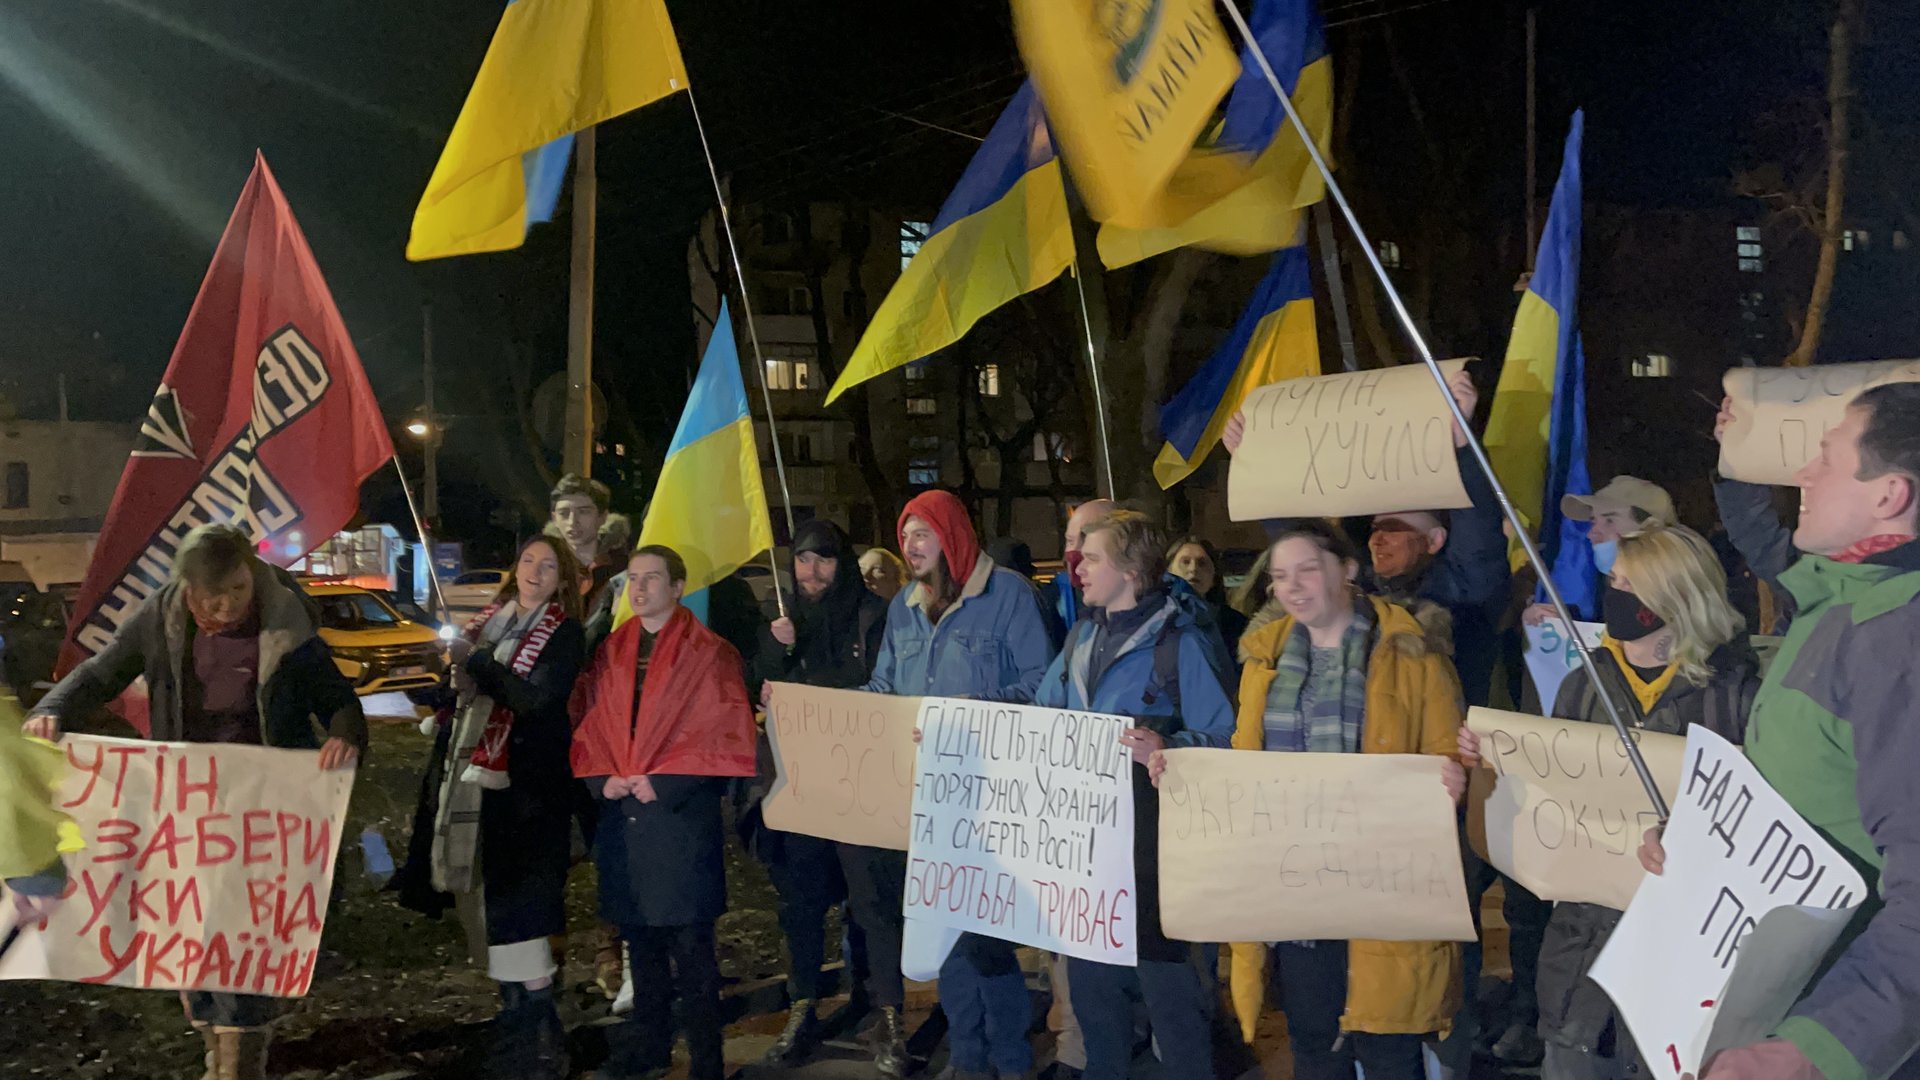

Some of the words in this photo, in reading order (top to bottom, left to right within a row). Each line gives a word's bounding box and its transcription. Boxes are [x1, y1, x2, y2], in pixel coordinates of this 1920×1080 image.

[1252, 372, 1386, 431] ПУТІН
[1301, 407, 1446, 496] ХУЙЛО
[775, 697, 885, 738] ВІРИМО
[920, 700, 1026, 766] ГІДНІСТЬ
[62, 743, 219, 812] УТІН
[830, 743, 914, 831] ЗСУ
[1168, 777, 1363, 841] УКРАЇНА
[1686, 747, 1754, 859] НАД
[92, 809, 331, 874] ЗАБЕРИ
[913, 813, 935, 845] ТА
[952, 817, 1030, 859] СМЕРТЬ
[1279, 841, 1451, 899] ЄДИНА
[38, 869, 203, 937] УКИ
[246, 872, 322, 944] ВІД
[907, 857, 1017, 930] БОРОТЬБА
[1031, 879, 1129, 951] ТРИВАЄ
[79, 924, 317, 996] УКРАЇНИ
